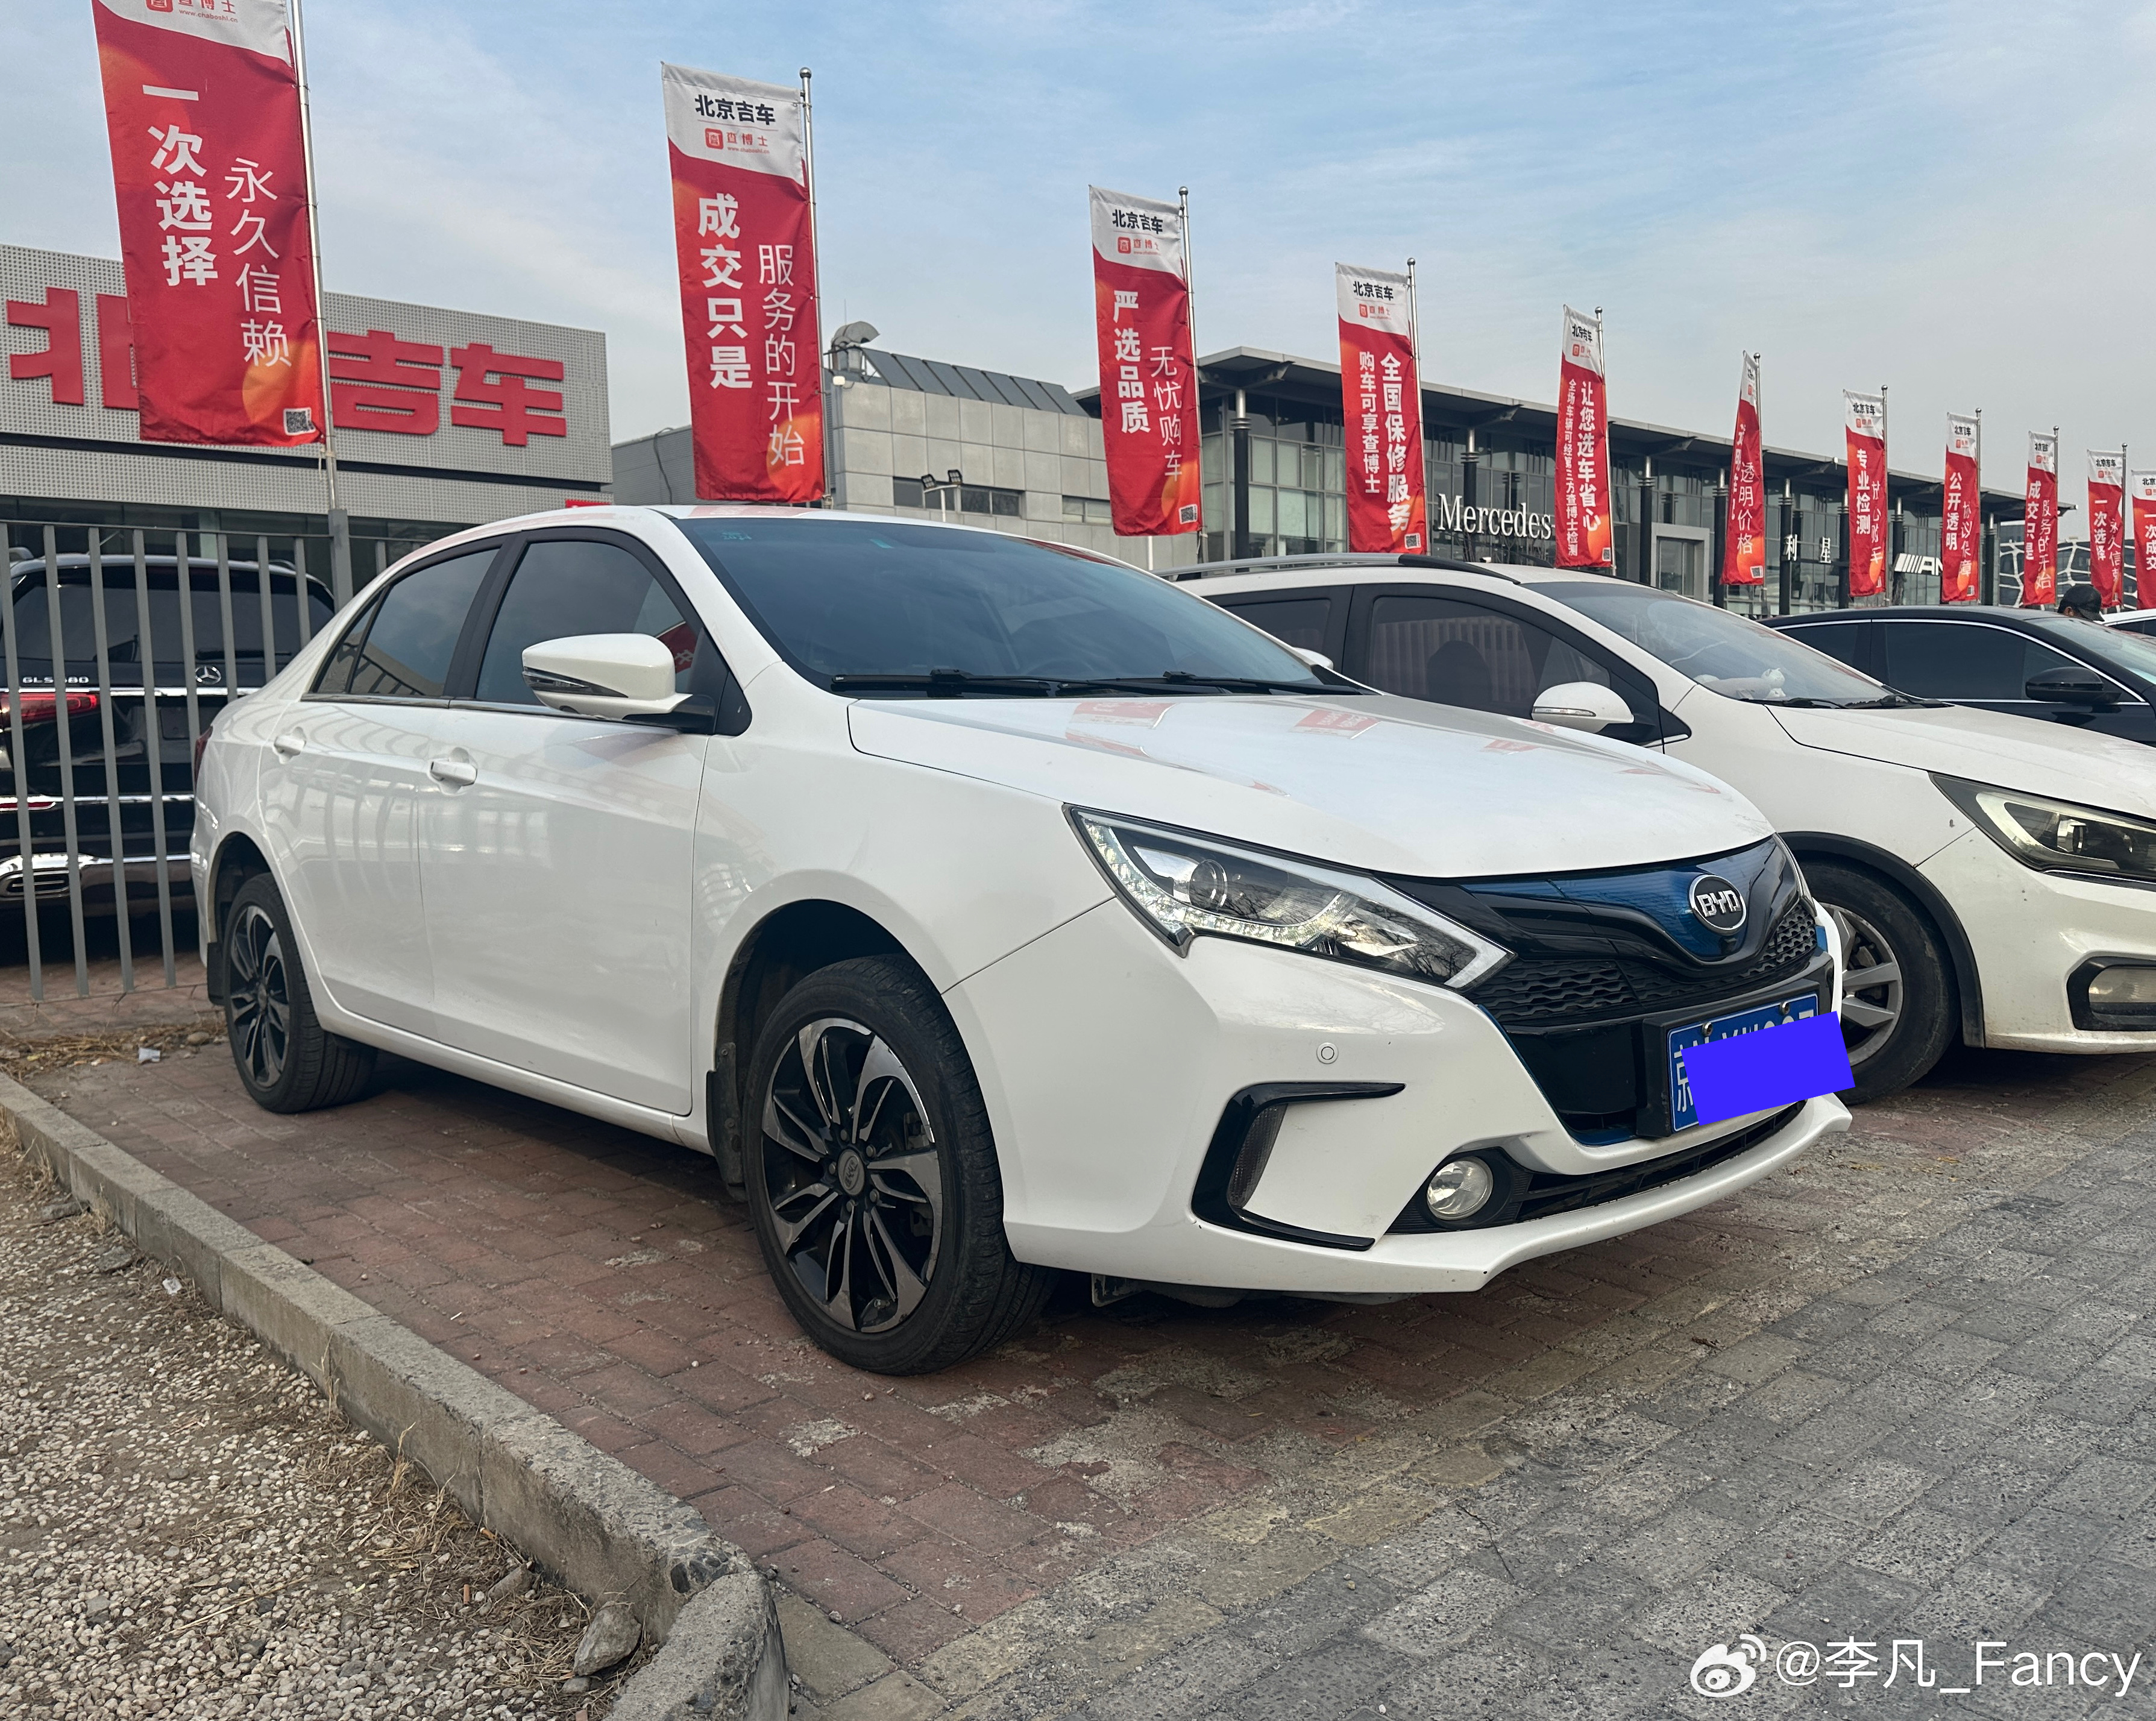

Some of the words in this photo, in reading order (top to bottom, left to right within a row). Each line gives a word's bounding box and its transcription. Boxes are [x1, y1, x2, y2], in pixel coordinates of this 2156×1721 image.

[694, 95, 776, 125] 北京吉车
[726, 131, 768, 147] 查博士
[143, 84, 218, 286] 一次选择
[1112, 209, 1163, 234] 北京吉车
[224, 157, 292, 367] 永久信赖
[697, 192, 753, 389] 成交只是
[1353, 281, 1394, 301] 北京吉车
[7, 287, 567, 446] 北吉车
[758, 244, 805, 467] 服务的开始
[1113, 290, 1151, 434] 严选品质
[1149, 346, 1183, 482] 无忧购车
[1359, 351, 1381, 494] 购车可享查博士
[1380, 352, 1411, 532] 全国保修服务
[1577, 381, 1601, 532] 让您选车省心
[1736, 462, 1756, 555] 透明价格
[1856, 448, 1871, 535] 专业检测
[1946, 472, 1963, 551] 公开透明
[2026, 480, 2041, 561] 成交只是
[2094, 499, 2108, 561] 一次选择
[1696, 890, 1742, 917] BYD
